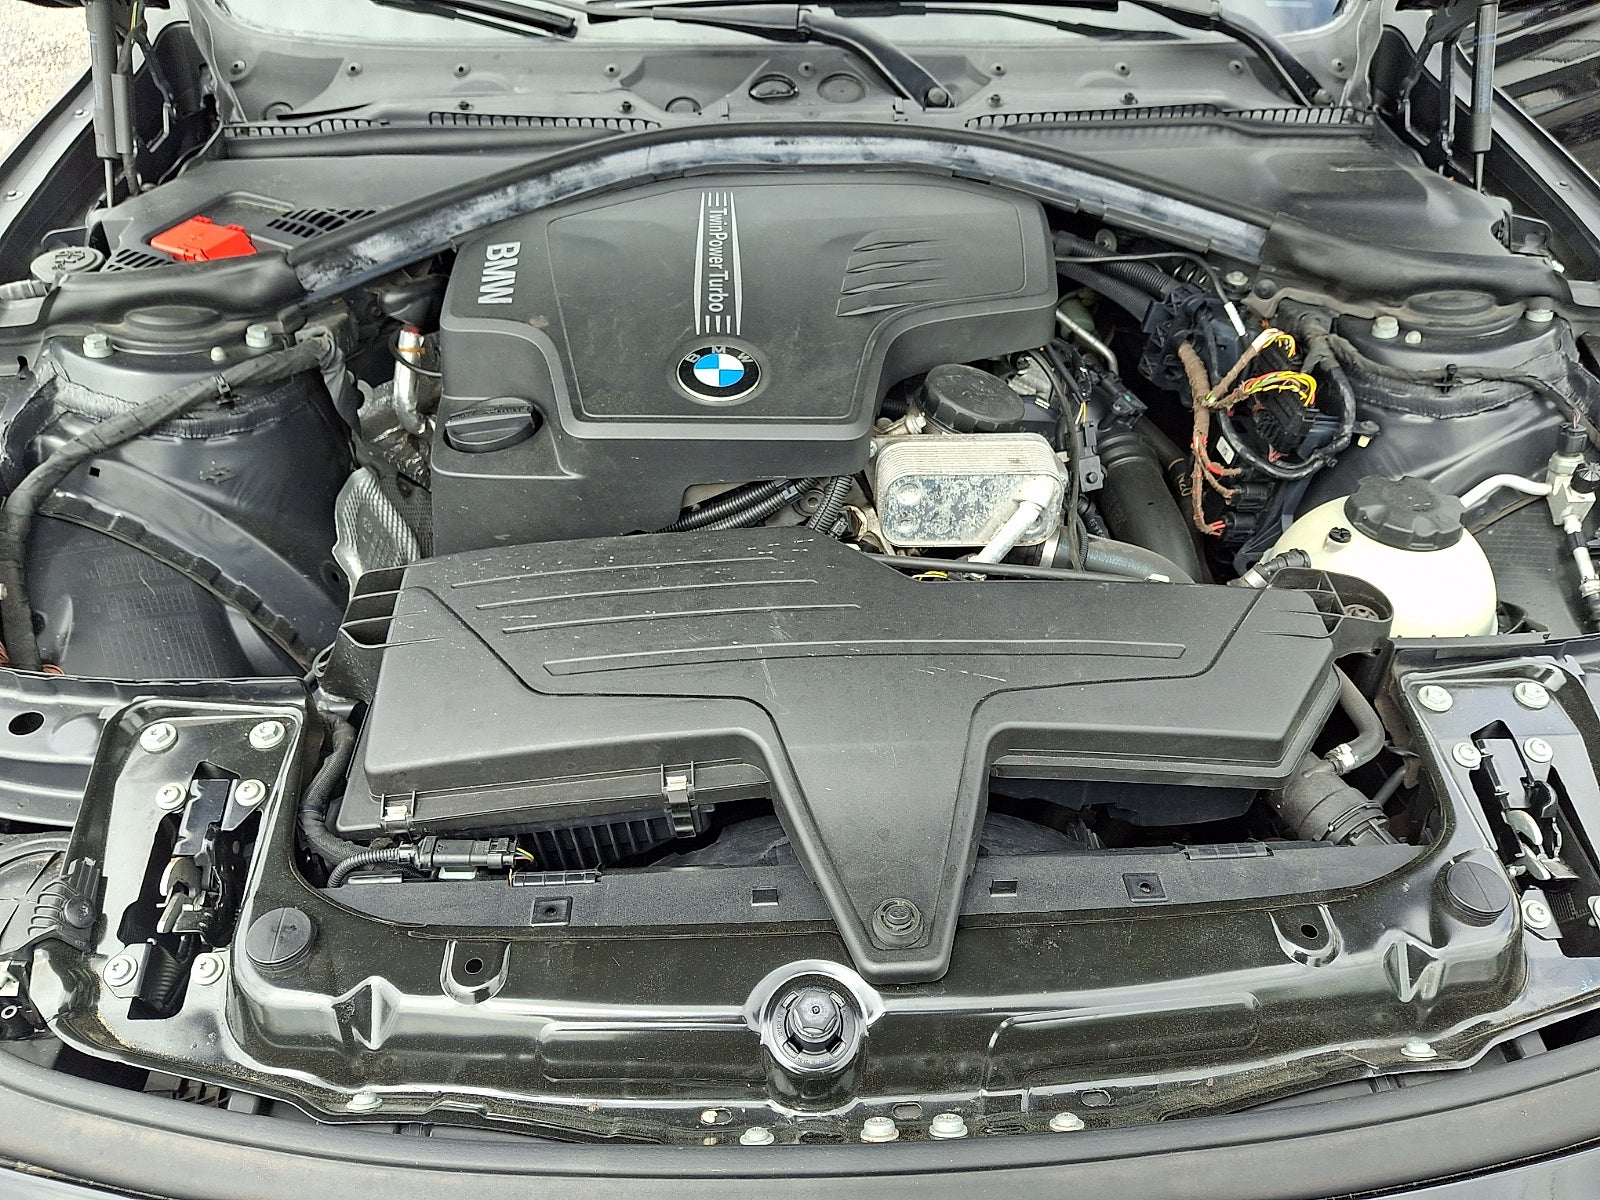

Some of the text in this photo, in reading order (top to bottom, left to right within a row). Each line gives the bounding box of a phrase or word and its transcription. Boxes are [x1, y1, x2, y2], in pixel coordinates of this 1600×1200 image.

[477, 241, 521, 304] BMW
[708, 207, 730, 313] TwinPower Turbo
[684, 345, 755, 364] BMW
